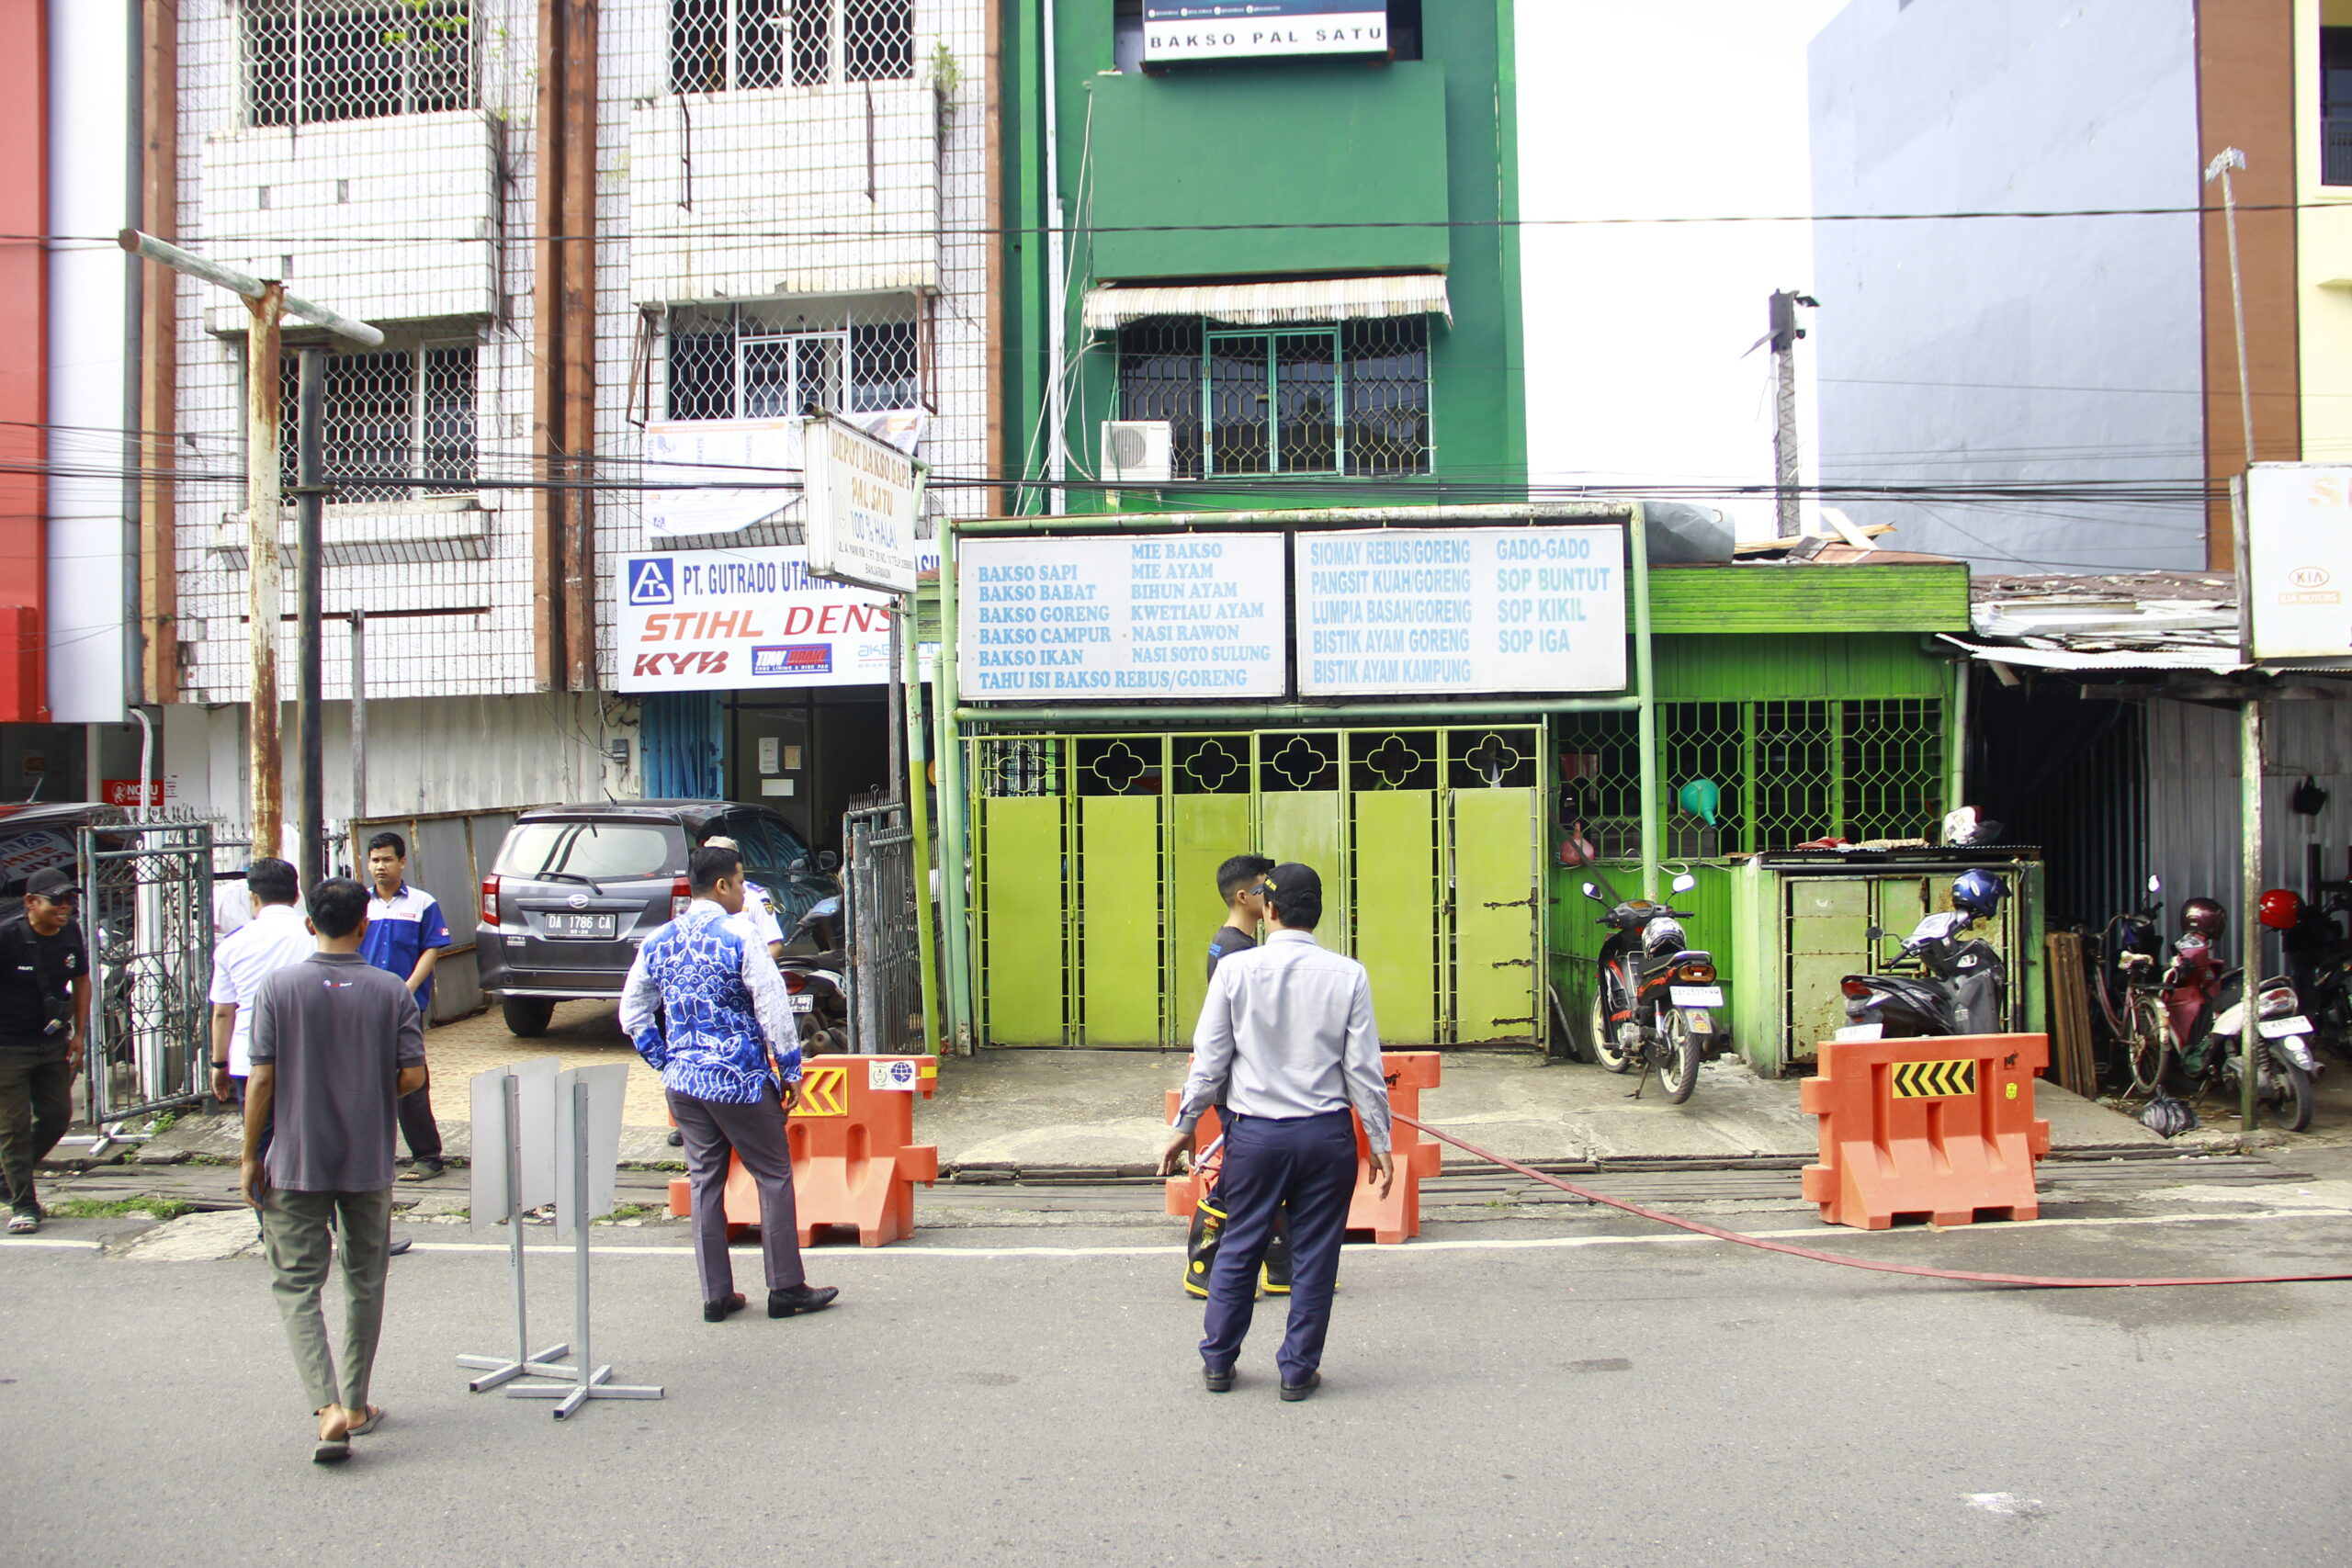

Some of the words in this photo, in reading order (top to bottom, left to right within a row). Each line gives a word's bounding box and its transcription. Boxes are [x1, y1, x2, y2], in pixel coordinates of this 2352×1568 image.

[1149, 33, 1236, 49] BAKSO
[1253, 30, 1298, 45] PAL
[1316, 27, 1382, 41] SATU
[831, 428, 861, 469] DEPOT
[863, 444, 890, 482] BAKSO
[892, 458, 910, 491] SAPI
[852, 477, 869, 507] PAL
[871, 484, 894, 518] SATU
[850, 509, 865, 540] 100
[875, 519, 899, 551] HALAL
[1131, 543, 1161, 559] MIE
[1165, 542, 1223, 558] BAKSO
[1310, 541, 1363, 567] SIOMAY
[1366, 538, 1471, 566] REBUS/GORENG
[1496, 537, 1591, 561] GADO-GADO
[683, 565, 704, 596] PT.
[708, 561, 775, 594] GUTRADO
[865, 562, 892, 581] BANJARMASIN
[978, 565, 1036, 582] BAKSO
[1039, 564, 1077, 581] SAPI
[1131, 563, 1161, 579] MIE
[1166, 563, 1214, 579] AYAM
[1311, 570, 1369, 595] PANGSIT
[1372, 568, 1471, 594] KUAH/GORENG
[1497, 568, 1532, 592] SOP
[1538, 567, 1611, 592] BUNTUT
[2297, 571, 2324, 583] KIA
[978, 584, 1036, 602] BAKSO
[1039, 583, 1097, 601] BABAT
[1131, 583, 1185, 600] BIHUN
[1189, 581, 1238, 598] AYAM
[783, 603, 891, 636] DENS
[978, 606, 1036, 624] BAKSO
[1039, 605, 1111, 622] GORENG
[1131, 604, 1212, 621] KWETIAU
[1216, 602, 1264, 618] AYAM
[1312, 600, 1363, 626] LUMPIA
[1366, 598, 1472, 625] BASAH/GORENG
[1498, 598, 1532, 624] SOP
[1538, 597, 1588, 623] KIKIL
[639, 609, 764, 643] STIHL
[978, 627, 1037, 645] BAKSO
[1039, 626, 1112, 644] CAMPUR
[1132, 626, 1173, 641] NASI
[1176, 624, 1239, 641] RAWON
[1313, 629, 1363, 655] BISTIK
[1365, 629, 1405, 654] AYAM
[1408, 627, 1471, 653] GORENG
[1498, 628, 1534, 654] SOP
[1539, 628, 1572, 653] IGA
[632, 650, 730, 678] KYB
[786, 649, 829, 666] BRAKE
[978, 649, 1036, 667] BAKSO
[1039, 649, 1083, 666] IKAN
[1132, 647, 1168, 663] NASI
[1170, 646, 1209, 662] SOTO
[1212, 645, 1271, 661] SULUNG
[978, 671, 1025, 690] TAHU
[1028, 670, 1051, 689] ISI
[1054, 670, 1112, 688] BAKSO
[1114, 669, 1248, 691] REBUS/GORENG
[1313, 660, 1360, 684] BISTIK
[1363, 660, 1399, 683] AYAM
[1402, 659, 1471, 683] KAMPUNG
[127, 784, 159, 795] NOU
[548, 916, 562, 929] DA
[570, 916, 594, 930] 1786
[598, 916, 612, 930] CA
